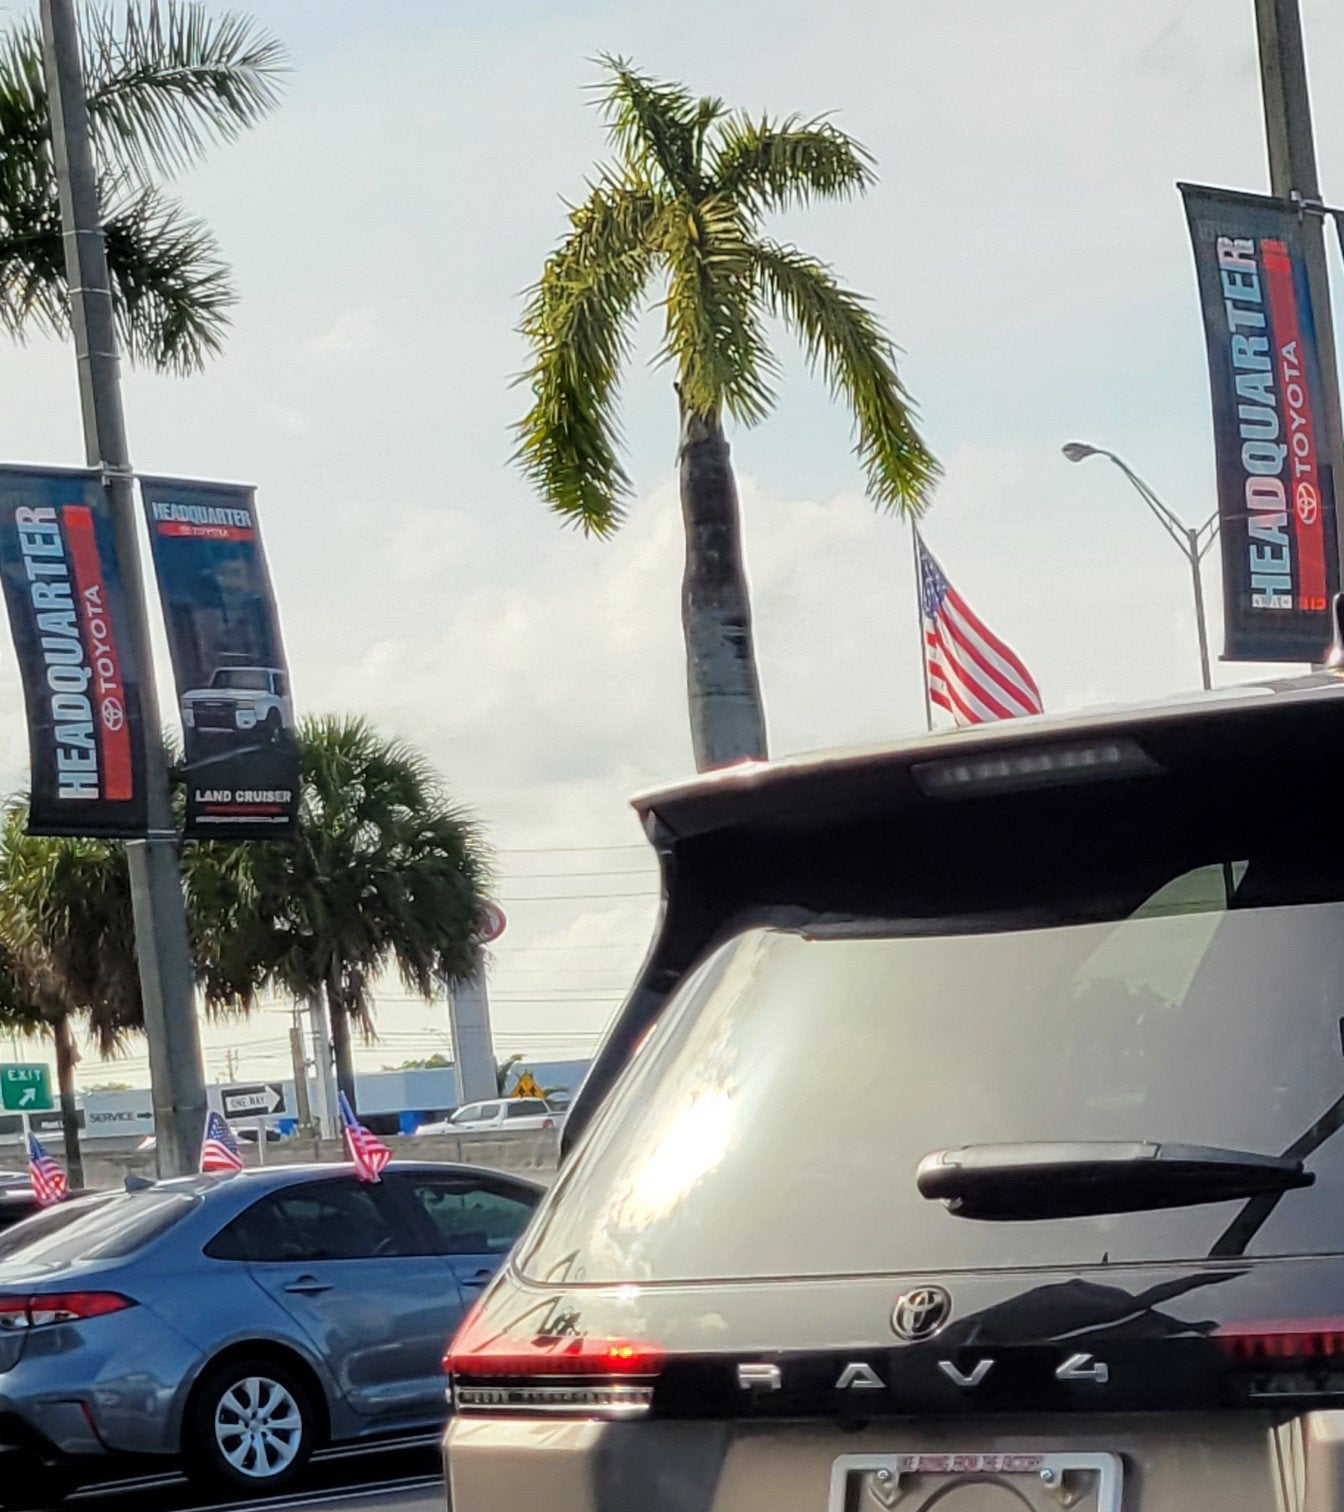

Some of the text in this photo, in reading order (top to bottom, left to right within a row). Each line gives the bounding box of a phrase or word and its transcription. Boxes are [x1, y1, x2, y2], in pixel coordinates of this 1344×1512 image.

[1281, 341, 1312, 477] TOYOTA
[1217, 236, 1293, 611] HEADQUARTER
[152, 502, 252, 527] HEADQUARTER
[84, 585, 117, 694] TOYOTA
[15, 505, 99, 800] HEADQUARTER
[195, 789, 292, 803] LAND CRUISER
[7, 1069, 42, 1082] EXIT
[231, 1094, 266, 1110] ONE WAY
[90, 1112, 134, 1123] SERVICE
